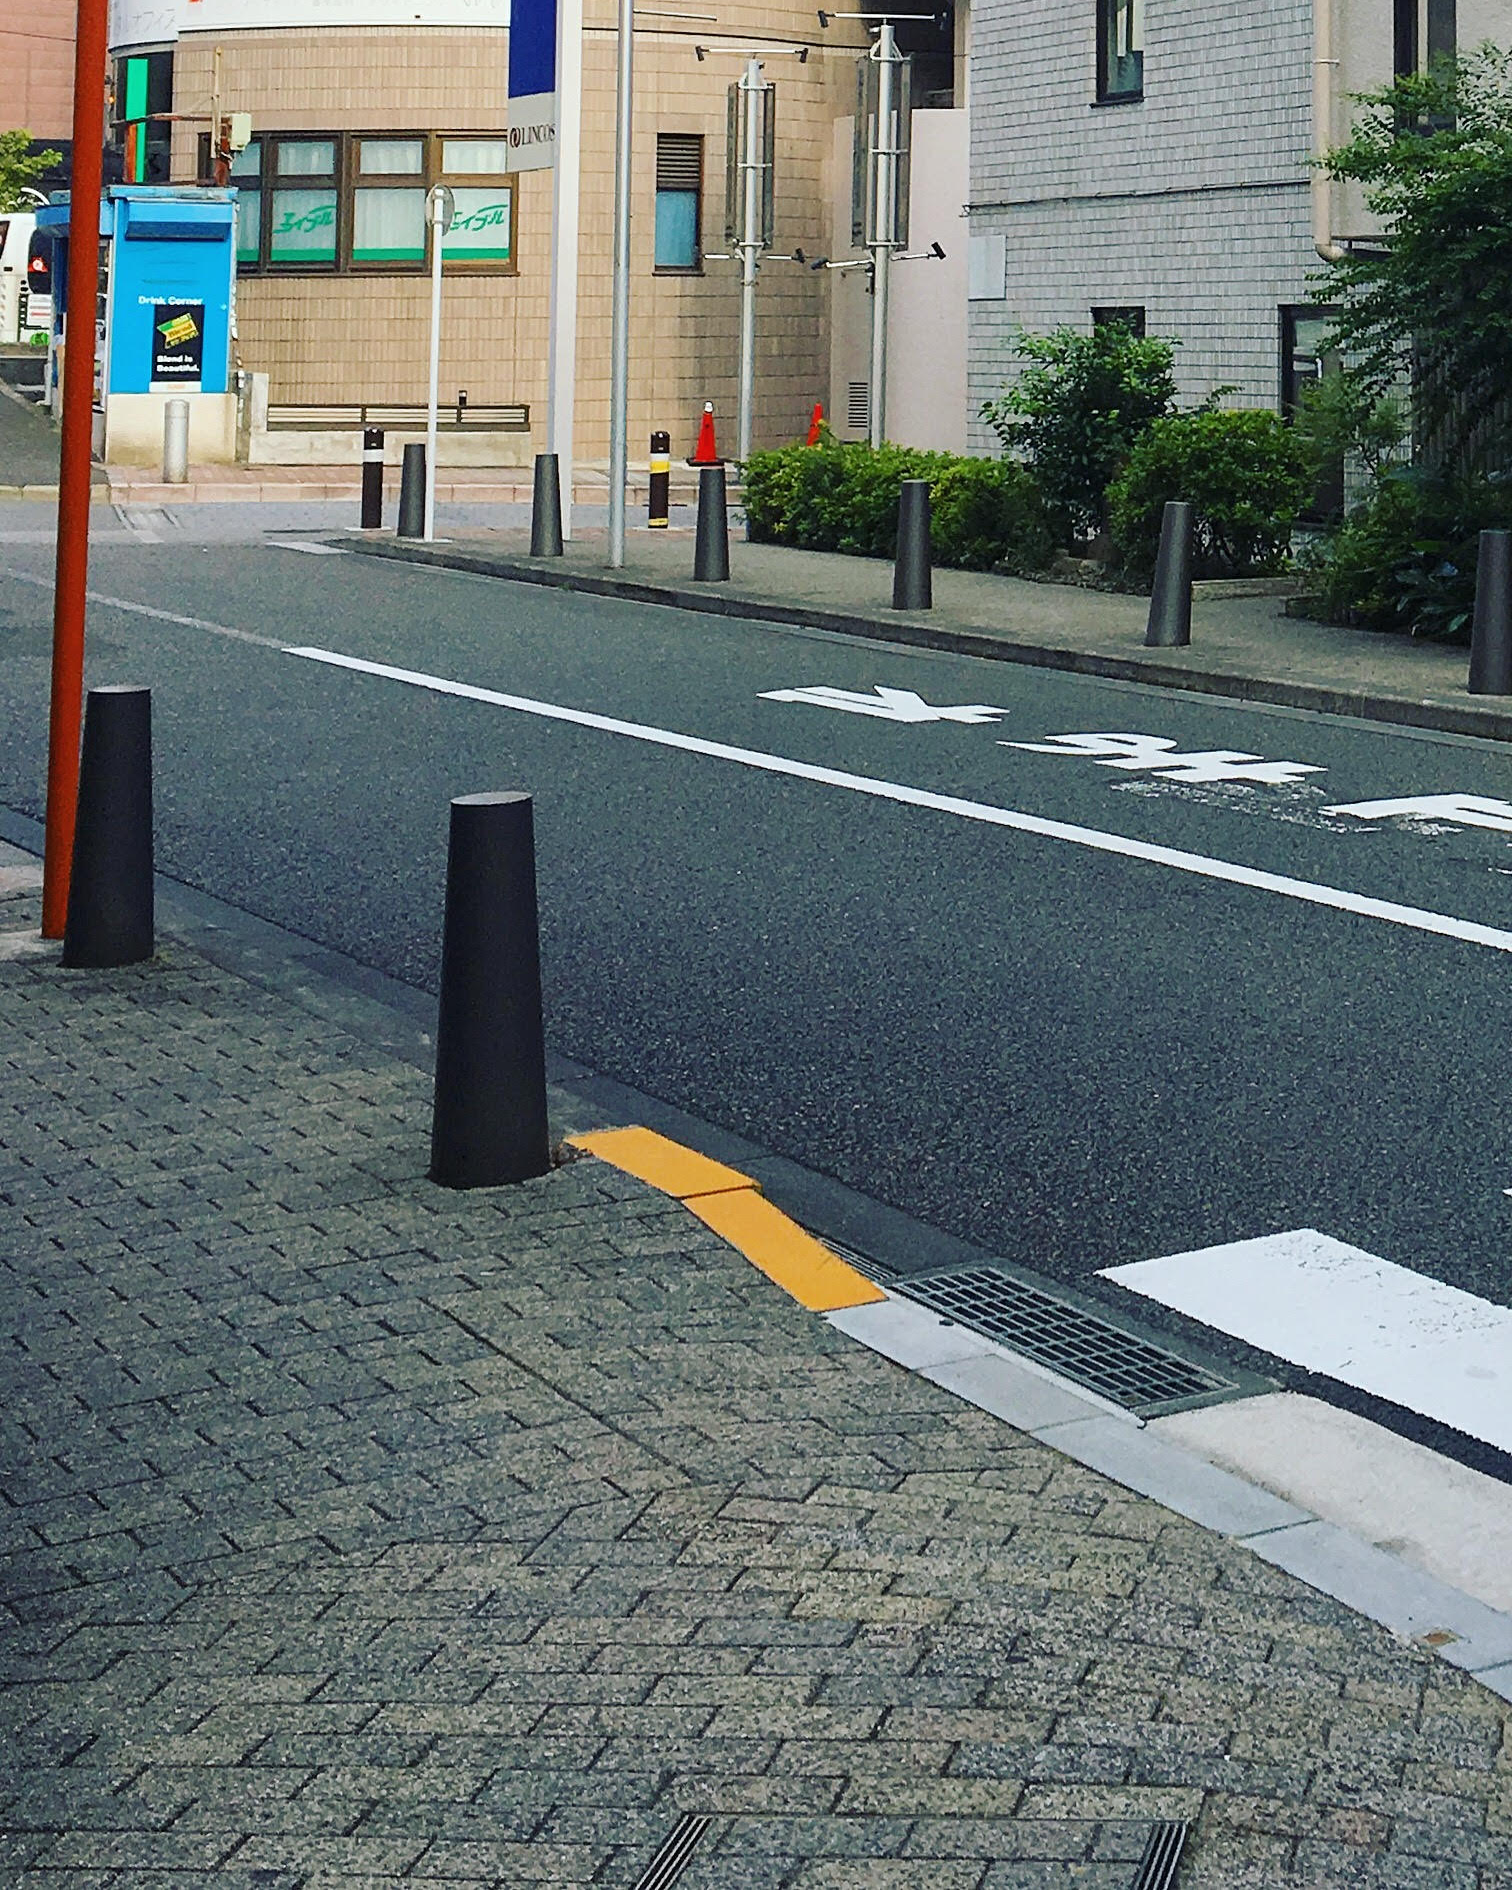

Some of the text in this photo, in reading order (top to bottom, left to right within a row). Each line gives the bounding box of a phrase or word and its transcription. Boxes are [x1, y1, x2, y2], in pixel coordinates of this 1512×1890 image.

[272, 205, 336, 234] エイブル
[138, 296, 203, 305] Drink Corner
